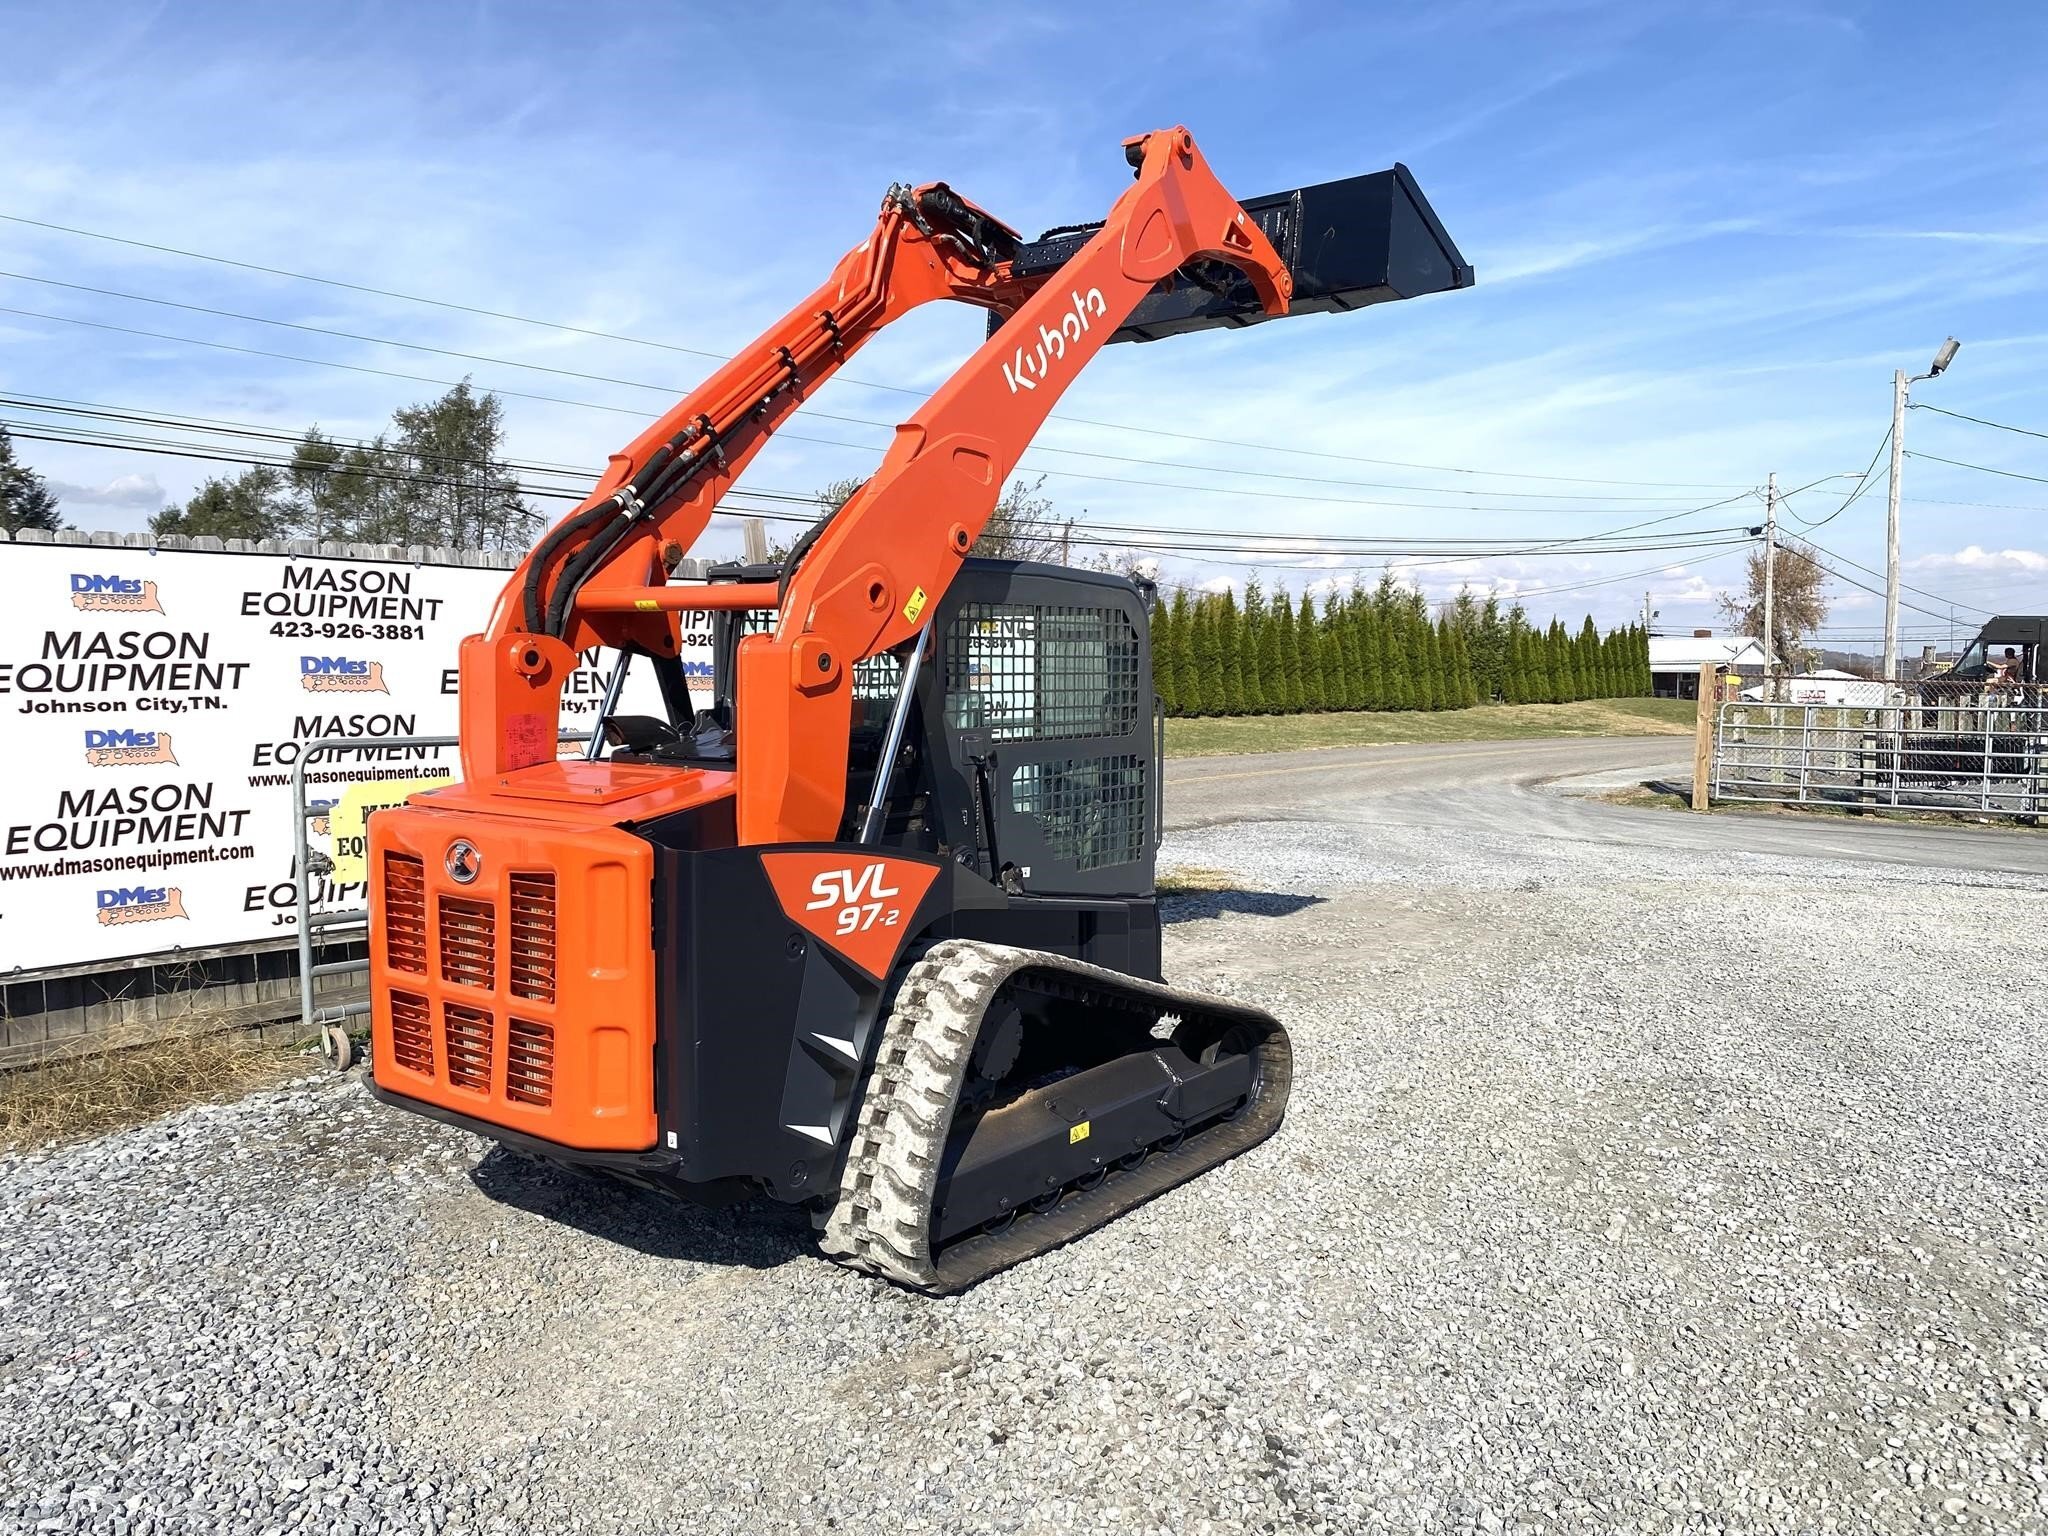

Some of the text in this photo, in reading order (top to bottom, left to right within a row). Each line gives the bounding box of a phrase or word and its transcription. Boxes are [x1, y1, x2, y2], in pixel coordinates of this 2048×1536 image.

[1002, 287, 1107, 394] Kubota
[282, 565, 411, 594] MASON
[240, 592, 443, 621] EQUIPMENT
[41, 631, 210, 660] MASON
[269, 622, 424, 640] 423-926-3881
[0, 663, 251, 693] EQUIPMENT
[18, 696, 228, 714] Johnson City,TN.
[293, 714, 416, 739] MASON
[248, 764, 450, 787] www.masonequipment.com
[57, 782, 213, 818] MASON
[5, 809, 251, 855] EQUIPMENT
[0, 844, 254, 881] www.dmasonequipment.com
[805, 863, 899, 911] SVL
[835, 902, 900, 936] 97-2
